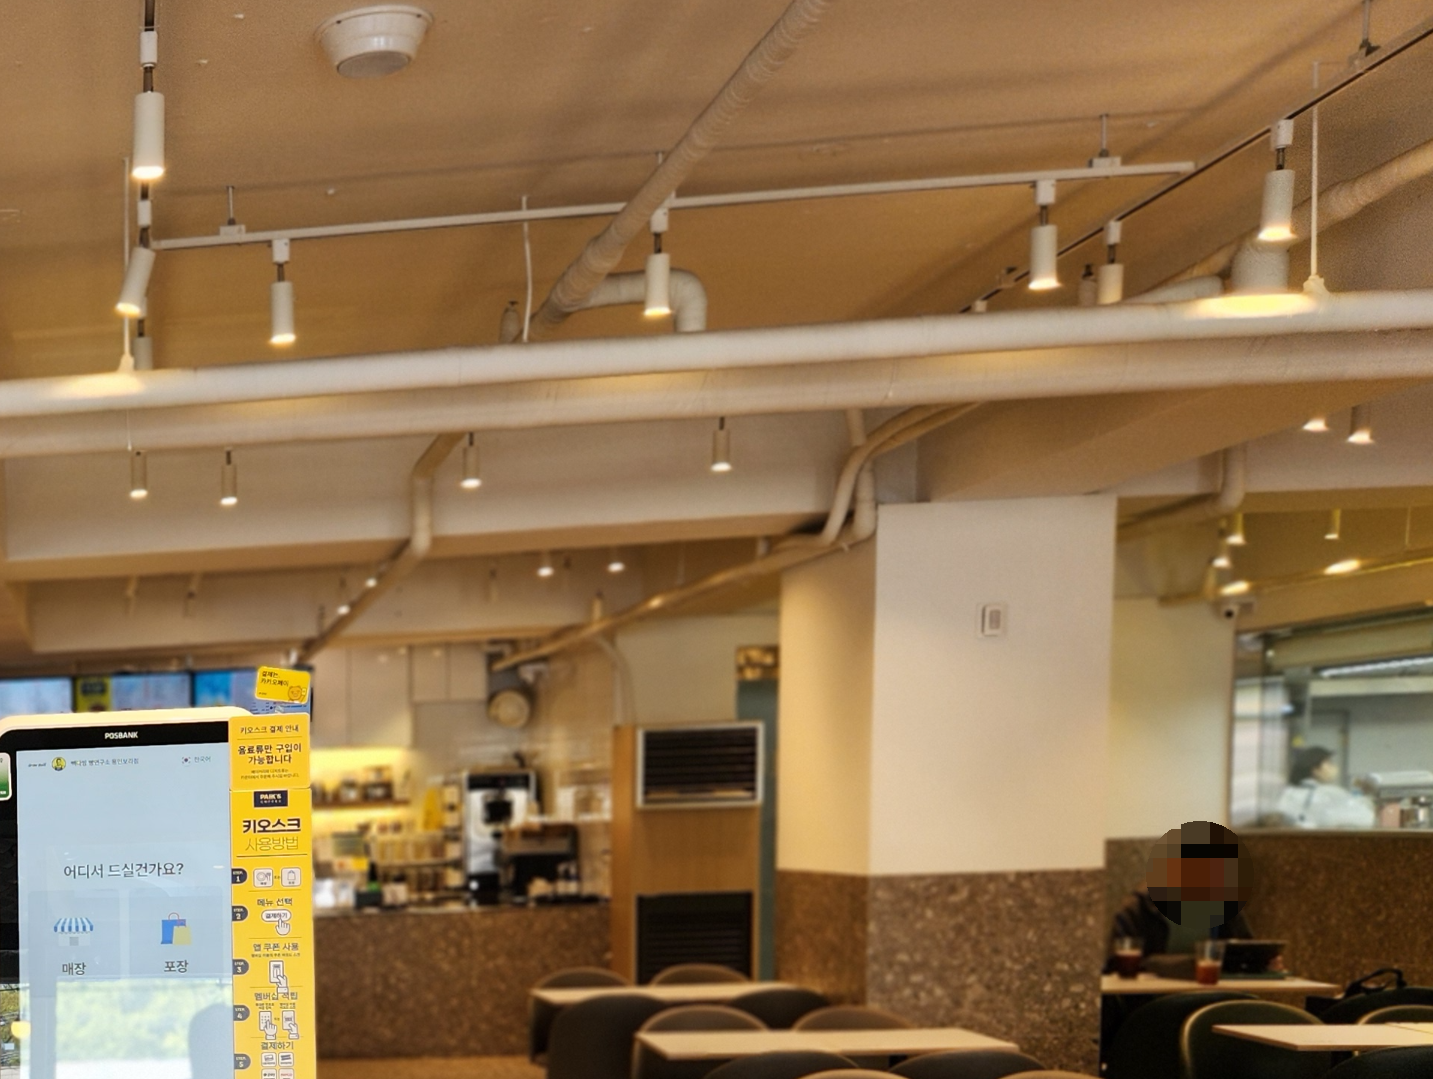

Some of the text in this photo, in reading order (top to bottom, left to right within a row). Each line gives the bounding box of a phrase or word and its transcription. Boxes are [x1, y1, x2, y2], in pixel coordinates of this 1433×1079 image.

[104, 731, 139, 740] POSBANK
[248, 754, 292, 765] 가능합니다
[242, 818, 301, 834] 키오스크
[245, 836, 299, 851] 사용방법
[63, 861, 185, 880] 어디서 드실건가요?
[62, 961, 87, 976] 매장
[163, 960, 189, 974] 포장
